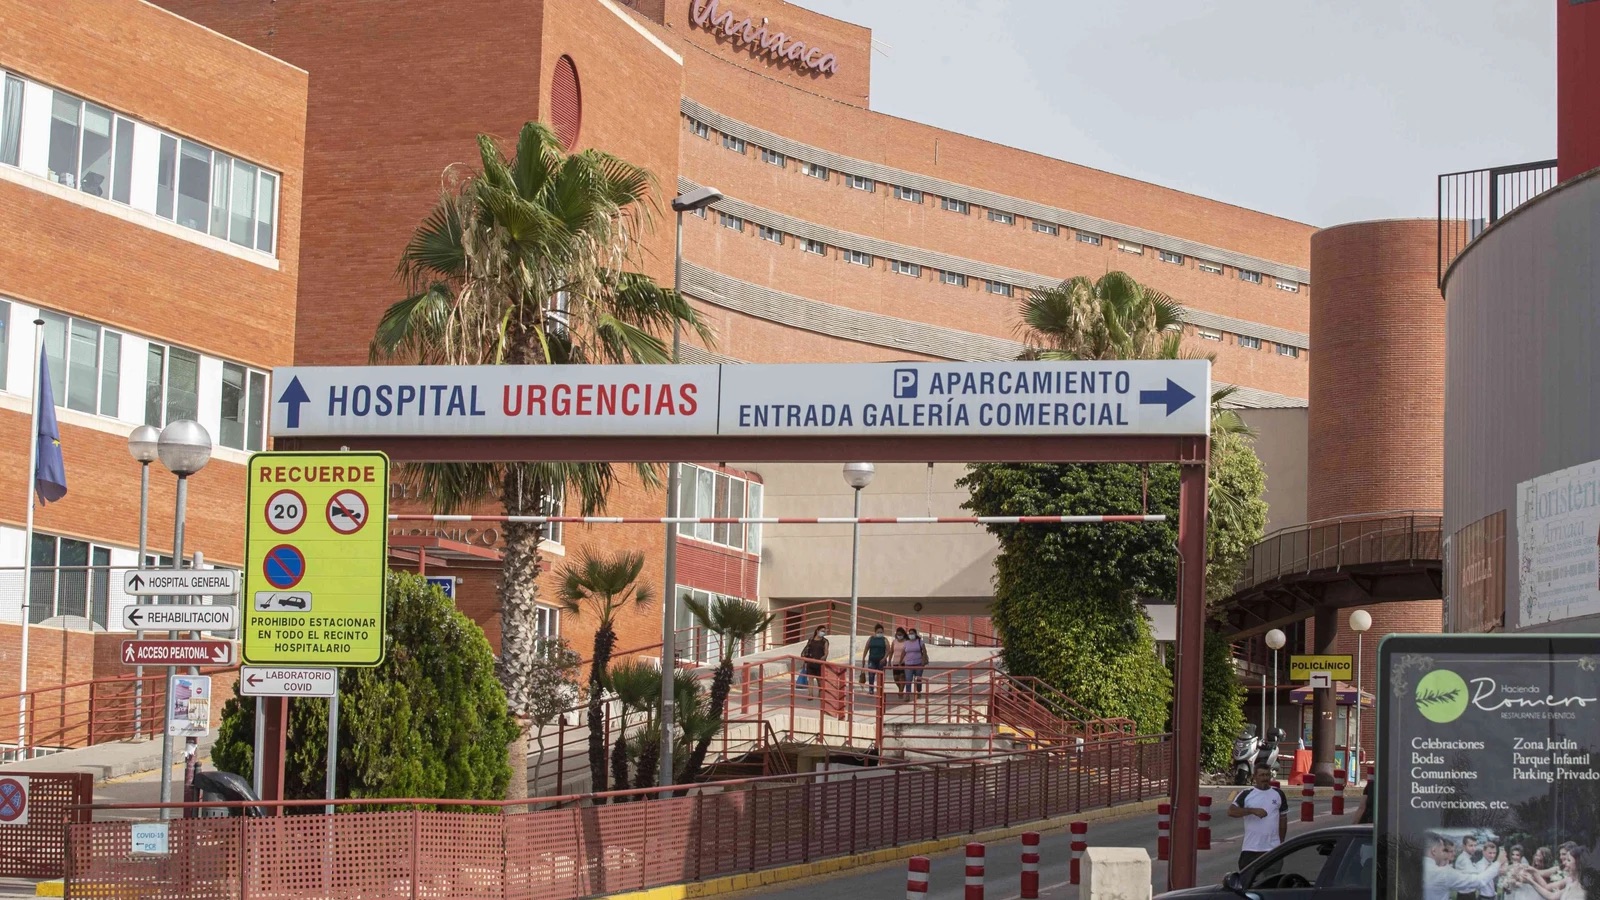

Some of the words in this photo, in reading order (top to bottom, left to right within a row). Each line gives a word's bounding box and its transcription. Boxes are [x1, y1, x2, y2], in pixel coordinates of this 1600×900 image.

[929, 370, 1131, 395] APARCAMIENTO
[328, 384, 485, 417] HOSPITAL
[503, 383, 698, 416] URGENCIAS
[739, 404, 853, 427] ENTRADA
[863, 398, 970, 426] GALERÍA
[980, 402, 1129, 426] COMERCIAL
[260, 466, 375, 482] RECUERDE
[274, 504, 298, 519] 20
[149, 577, 188, 588] HOSPITAL
[191, 577, 230, 588] GENERAL
[148, 612, 229, 623] REHABILITACION
[251, 617, 305, 627] PROHIBIDO
[310, 618, 376, 627] ESTACIONAR
[258, 630, 271, 639] EN
[276, 631, 303, 640] TODO
[308, 631, 319, 640] EL
[324, 631, 368, 640] RECINTO
[138, 646, 168, 659] ACCESO
[170, 646, 209, 659] PEATONAL
[274, 643, 350, 653] HOSPITALARIO
[1291, 661, 1351, 670] POLICLÍNICO
[265, 671, 331, 680] LABORATORIO
[283, 683, 312, 691] COVID
[1501, 685, 1540, 693] Hacienda
[1470, 677, 1597, 711] Romero
[1411, 736, 1485, 750] Celebraciones
[1513, 737, 1544, 750] Zona
[1546, 737, 1578, 751] Jardín
[1411, 752, 1445, 764] Bodas
[1513, 752, 1550, 768] Parque
[1553, 752, 1590, 765] Infantil
[1411, 767, 1478, 780] Comuniones
[1513, 767, 1554, 783] Parking
[1556, 767, 1600, 780] Privado
[1411, 781, 1455, 794] Bautizos
[1490, 799, 1509, 809] etc.
